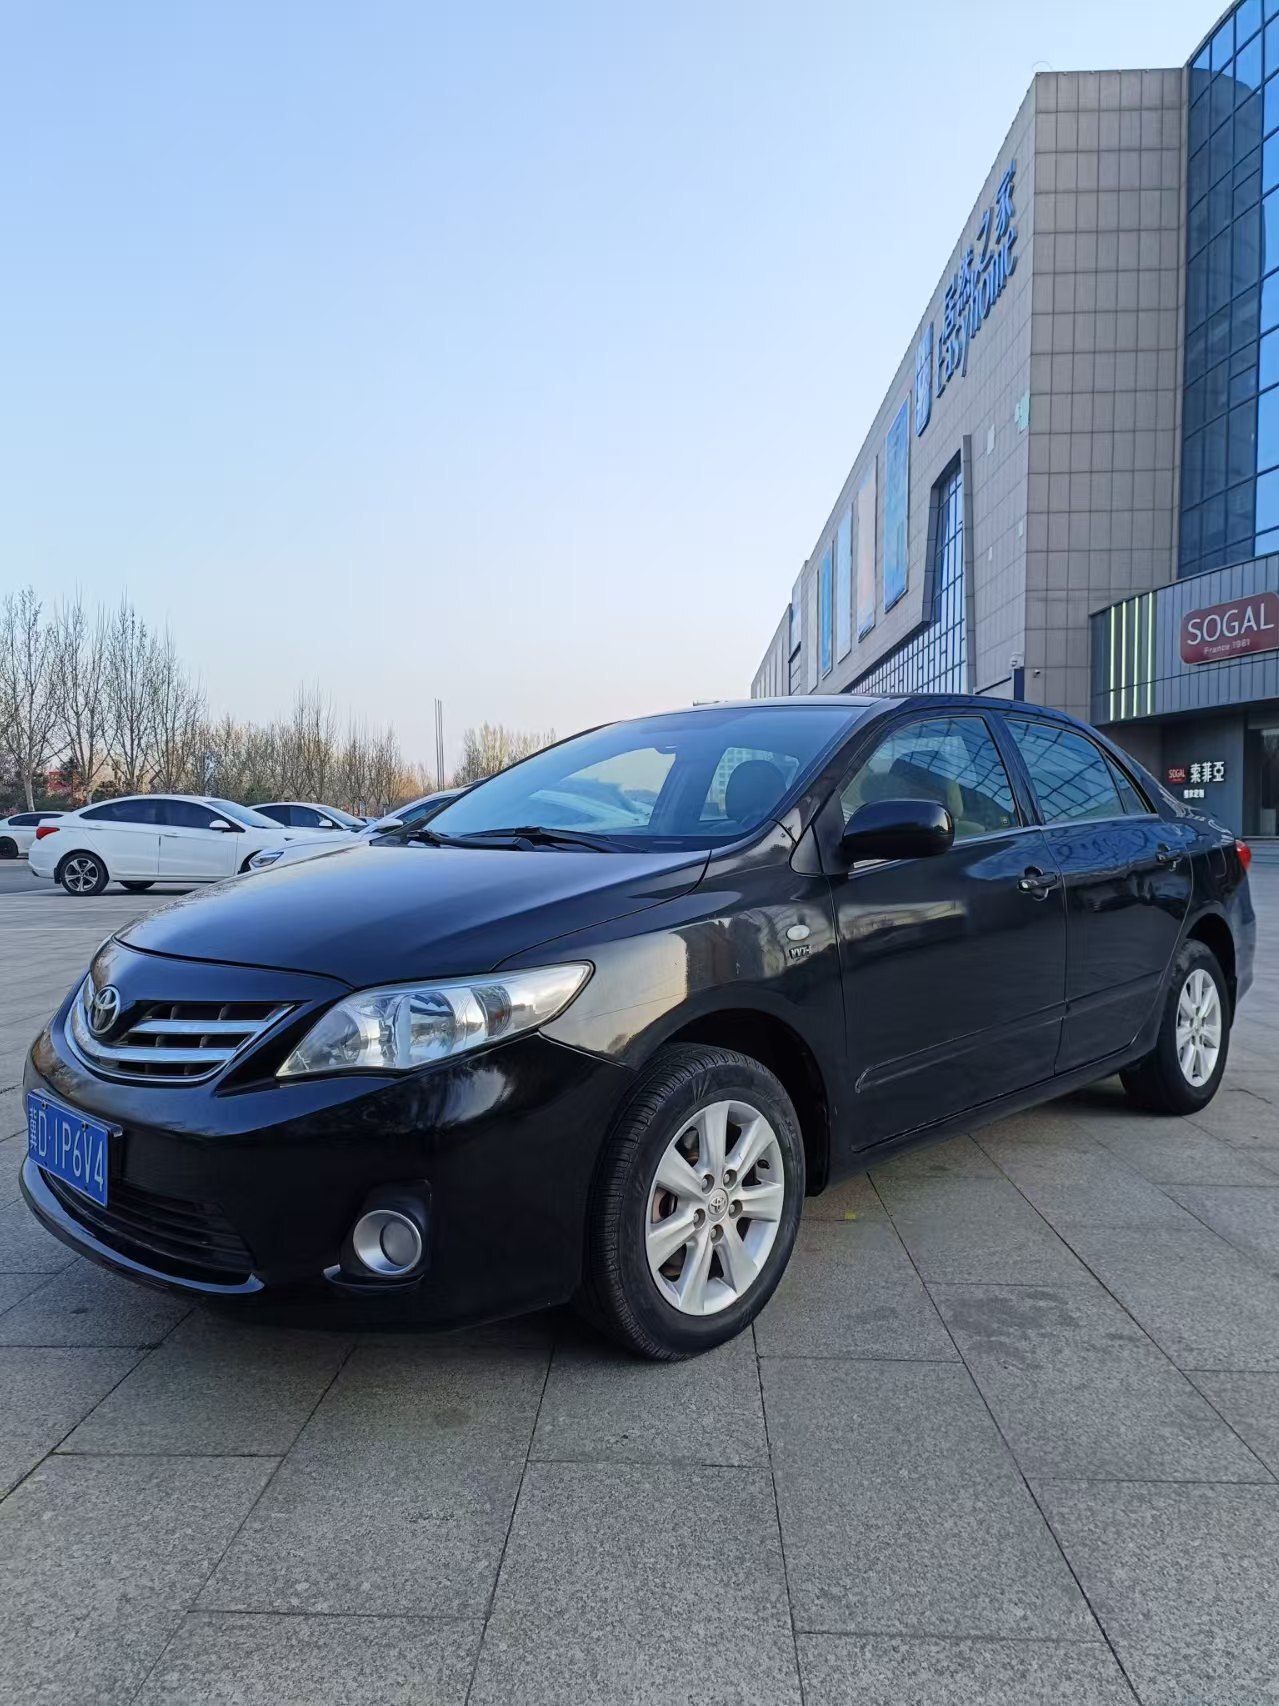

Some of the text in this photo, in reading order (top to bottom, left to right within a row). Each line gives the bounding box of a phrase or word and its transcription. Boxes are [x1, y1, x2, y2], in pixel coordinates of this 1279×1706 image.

[943, 159, 1016, 344] 居然之家
[1187, 603, 1274, 645] SOGAL
[1203, 645, 1230, 654] France
[1168, 768, 1185, 778] SOGAL
